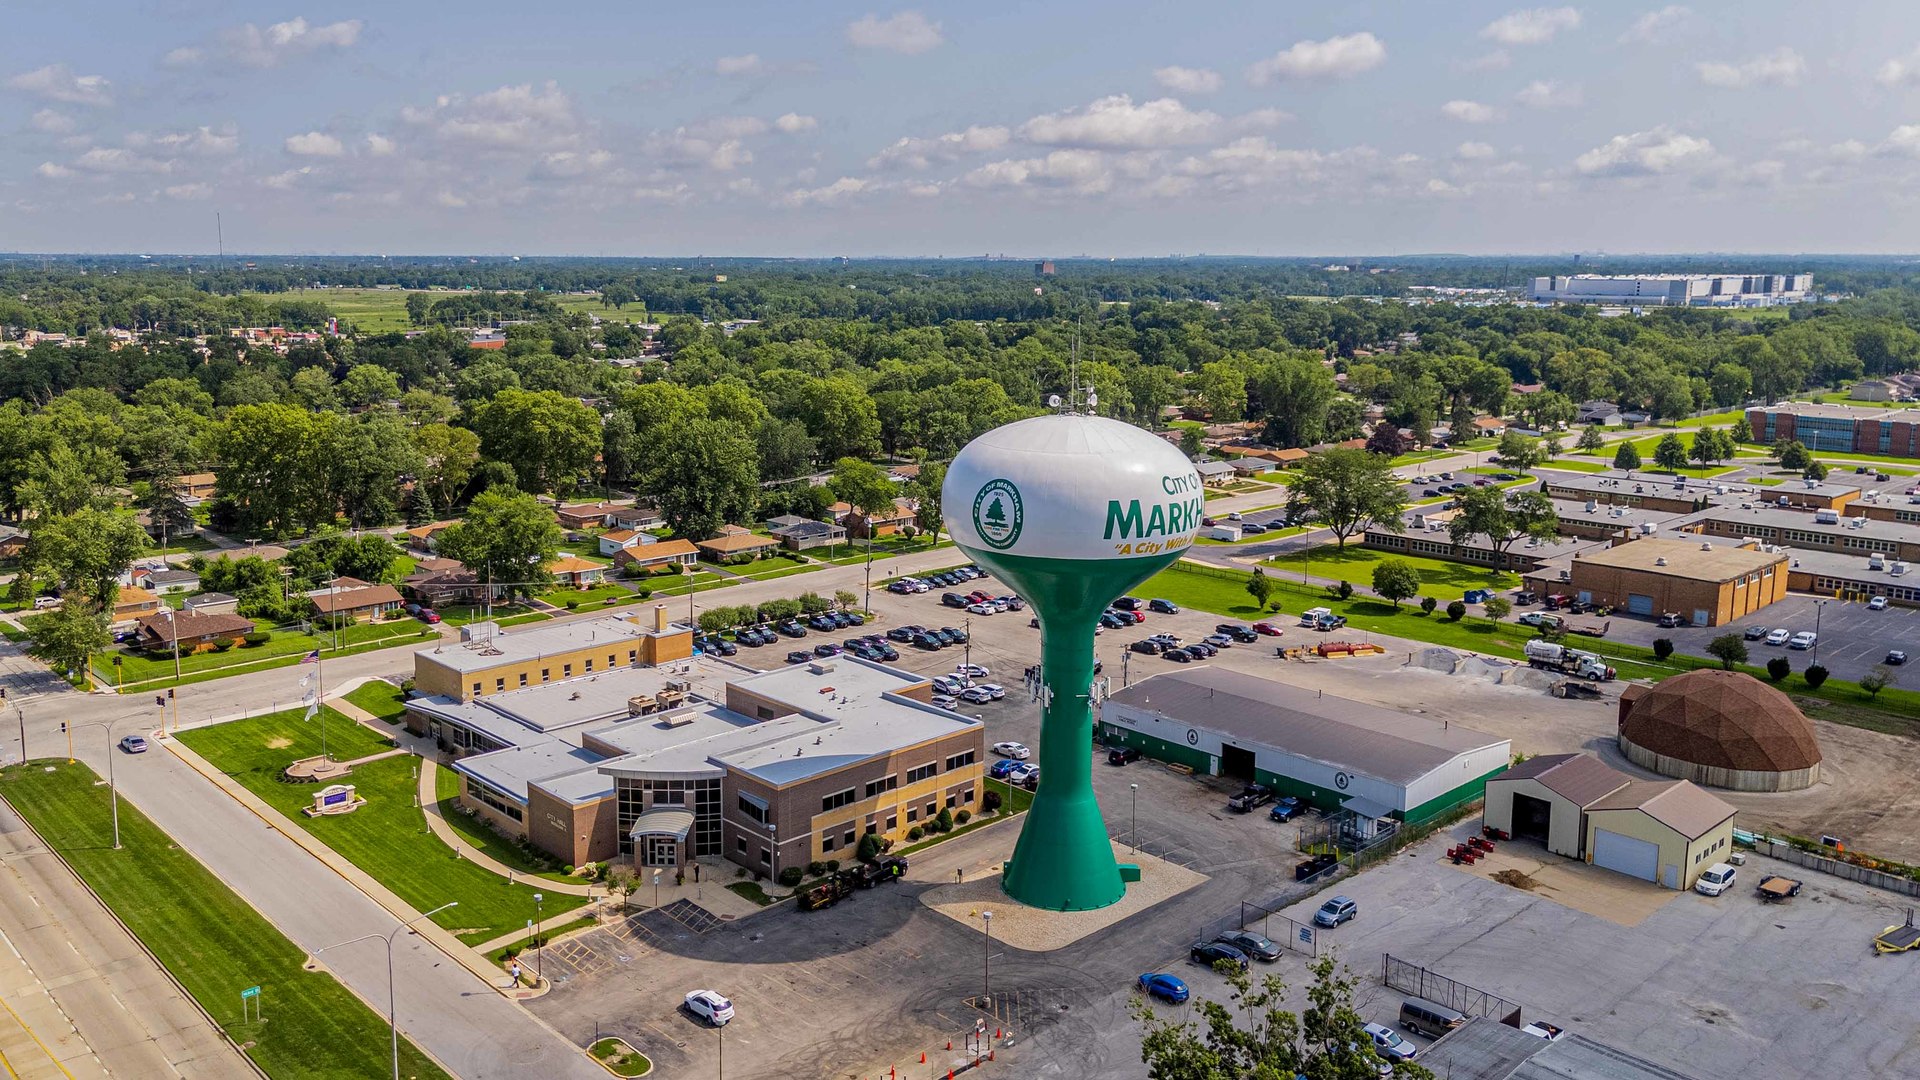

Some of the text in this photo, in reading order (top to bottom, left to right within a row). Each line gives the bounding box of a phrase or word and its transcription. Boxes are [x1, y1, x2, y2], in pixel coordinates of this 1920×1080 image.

[1162, 475, 1189, 495] CITY
[974, 481, 1021, 523] CITY OF MARKHAM
[1135, 541, 1163, 555] City
